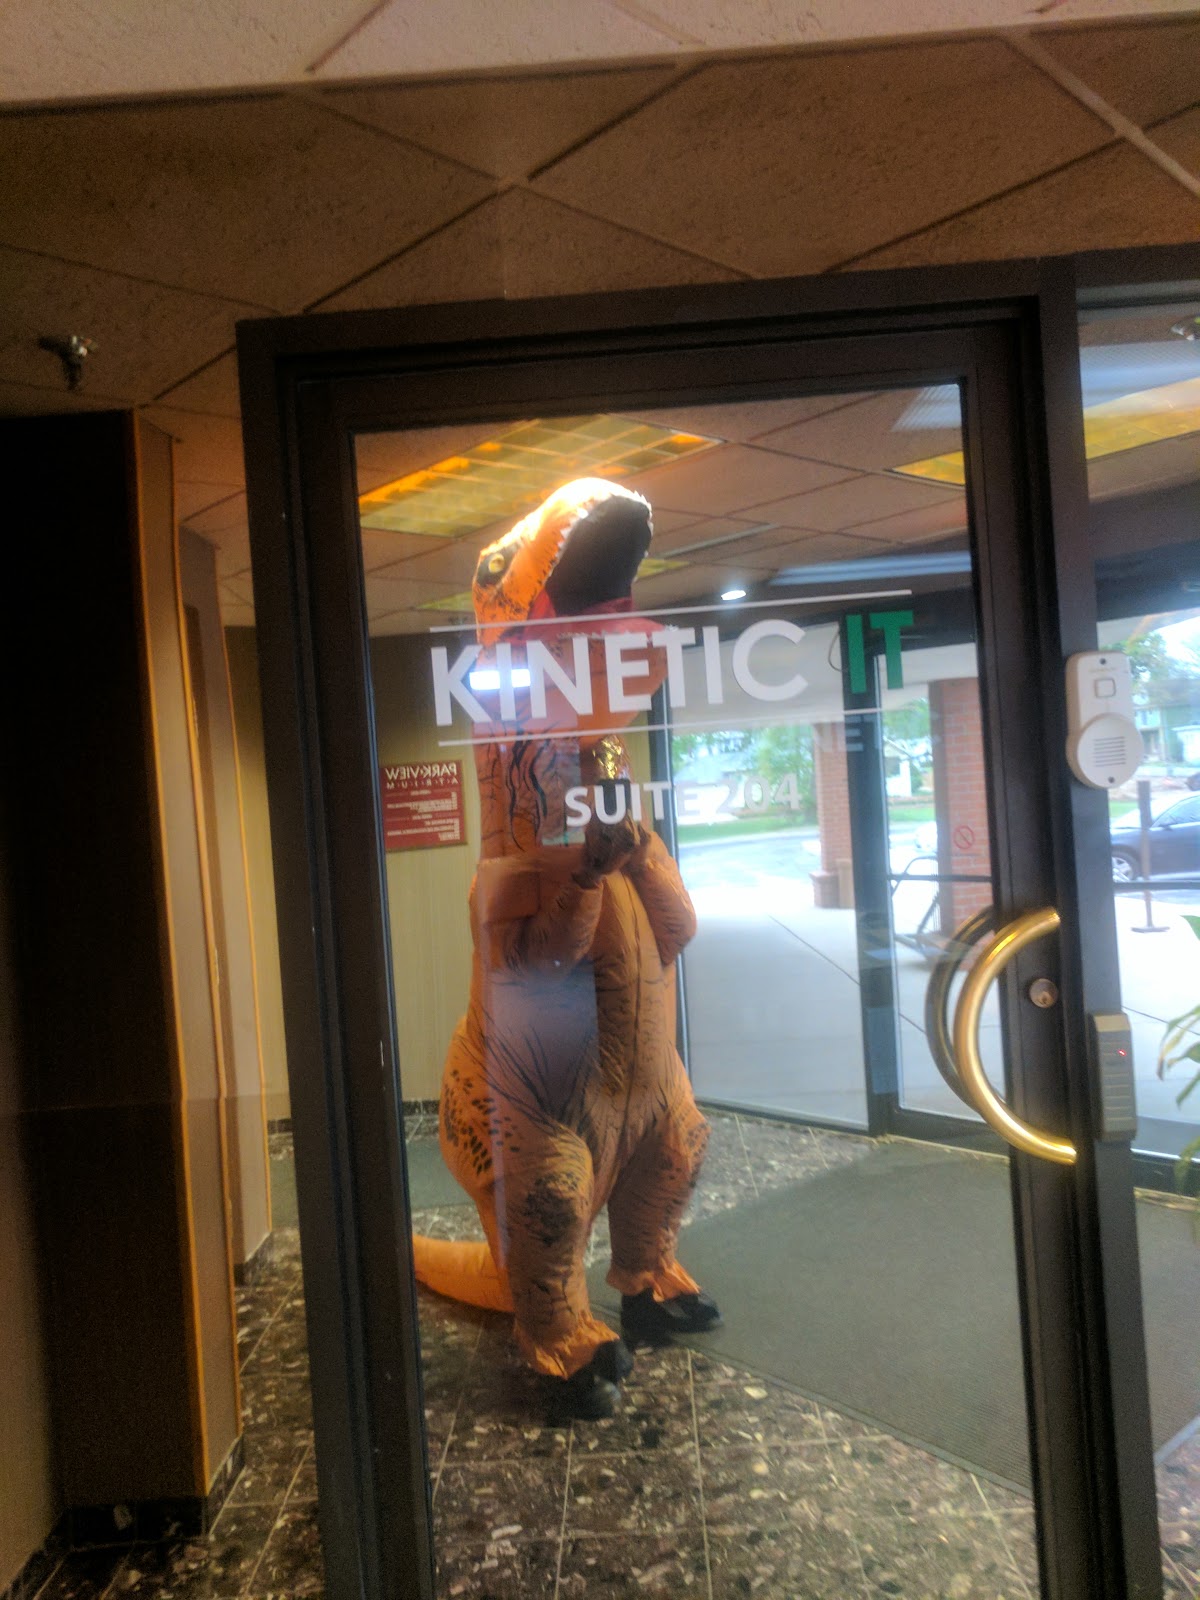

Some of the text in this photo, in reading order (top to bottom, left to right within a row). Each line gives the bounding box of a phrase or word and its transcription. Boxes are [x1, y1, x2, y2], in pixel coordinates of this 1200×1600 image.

[430, 610, 914, 726] KINETIC IT
[565, 773, 802, 826] SUITE 204
